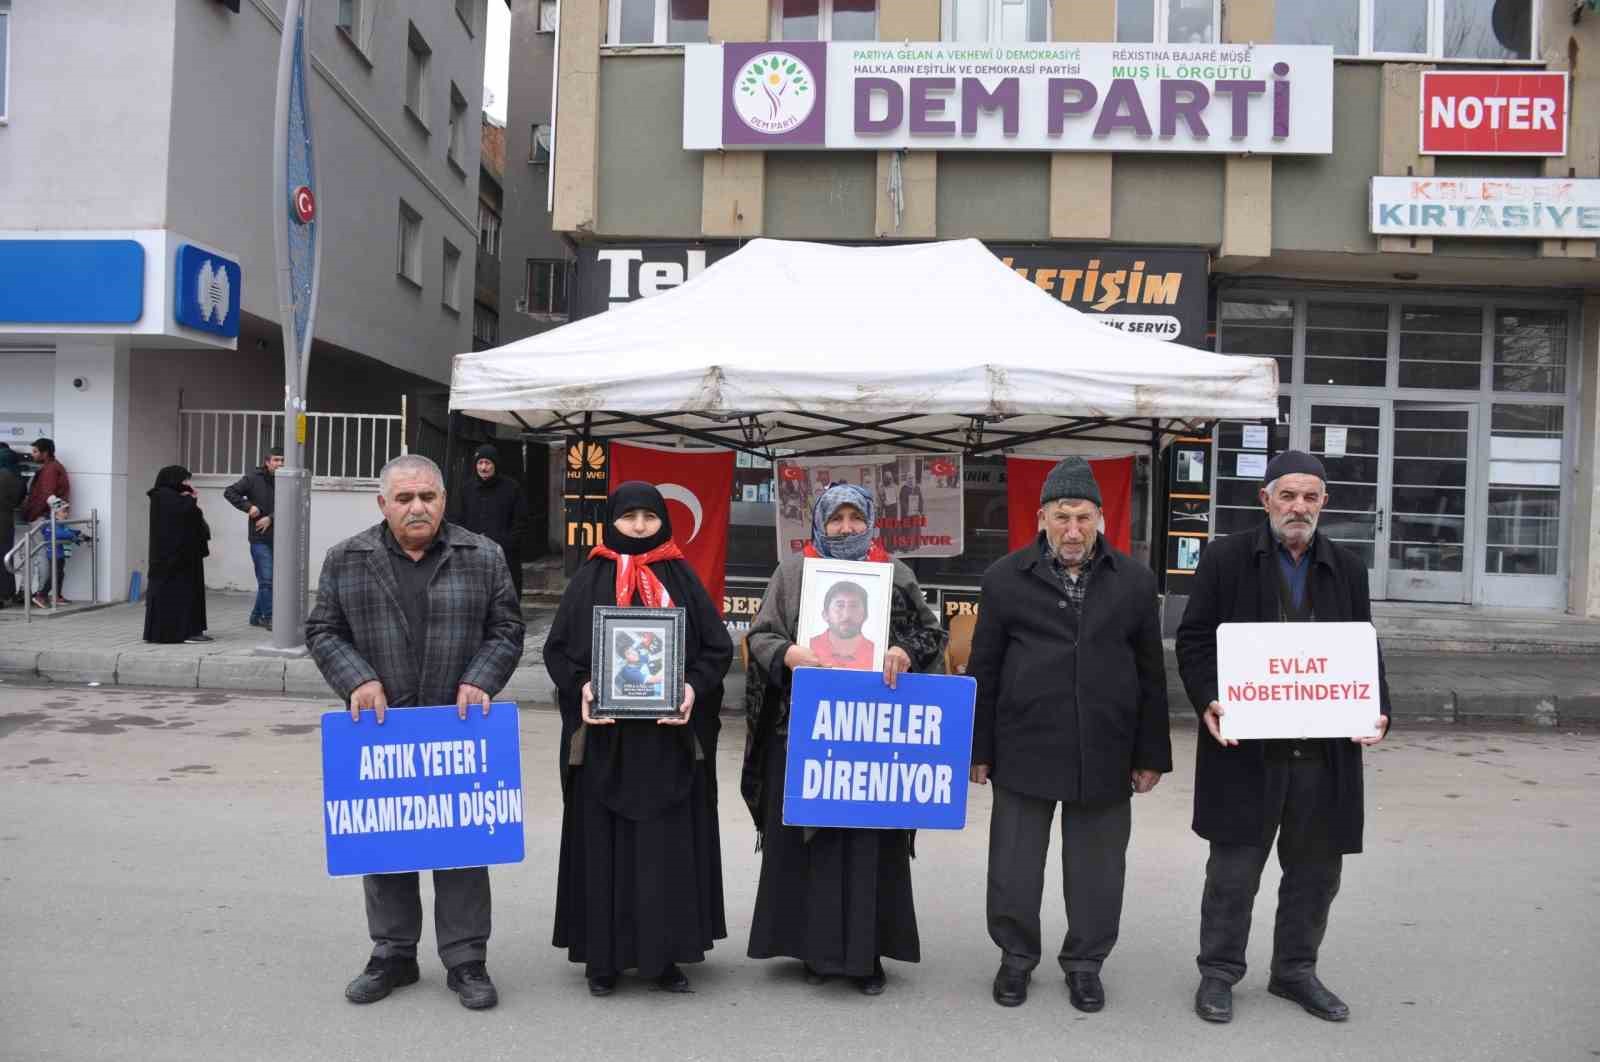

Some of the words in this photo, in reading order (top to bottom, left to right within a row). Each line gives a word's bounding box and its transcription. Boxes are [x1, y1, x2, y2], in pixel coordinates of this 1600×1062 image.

[897, 50, 933, 60] GELAN
[936, 50, 944, 60] A
[853, 65, 914, 74] HALKLARIN
[916, 64, 957, 76] EŞİTLİK
[959, 65, 973, 74] VE
[975, 64, 1036, 74] DEMOKRASİ
[1039, 64, 1081, 74] PARTİSİ
[1112, 66, 1150, 80] MUŞ
[1155, 64, 1171, 79] İL
[1176, 64, 1253, 79] ÖRGÜTÜ
[854, 77, 1020, 136] DEM
[1047, 61, 1290, 138] PARTİ
[1431, 96, 1557, 130] NOTER
[1378, 201, 1600, 230] KIRTASİYE
[1127, 319, 1177, 334] SERVİS
[567, 471, 606, 480] HUWEI
[1269, 657, 1328, 675] EVLAT
[1227, 680, 1371, 702] NÖBETİNDEYİZ
[811, 700, 943, 746] ANNELER
[359, 743, 417, 781] ARTIK
[419, 739, 476, 777] YETER
[802, 748, 953, 804] DİRENİYOR
[326, 793, 454, 835] YAKAMIZDAN
[459, 780, 522, 835] DÜŞÜN
